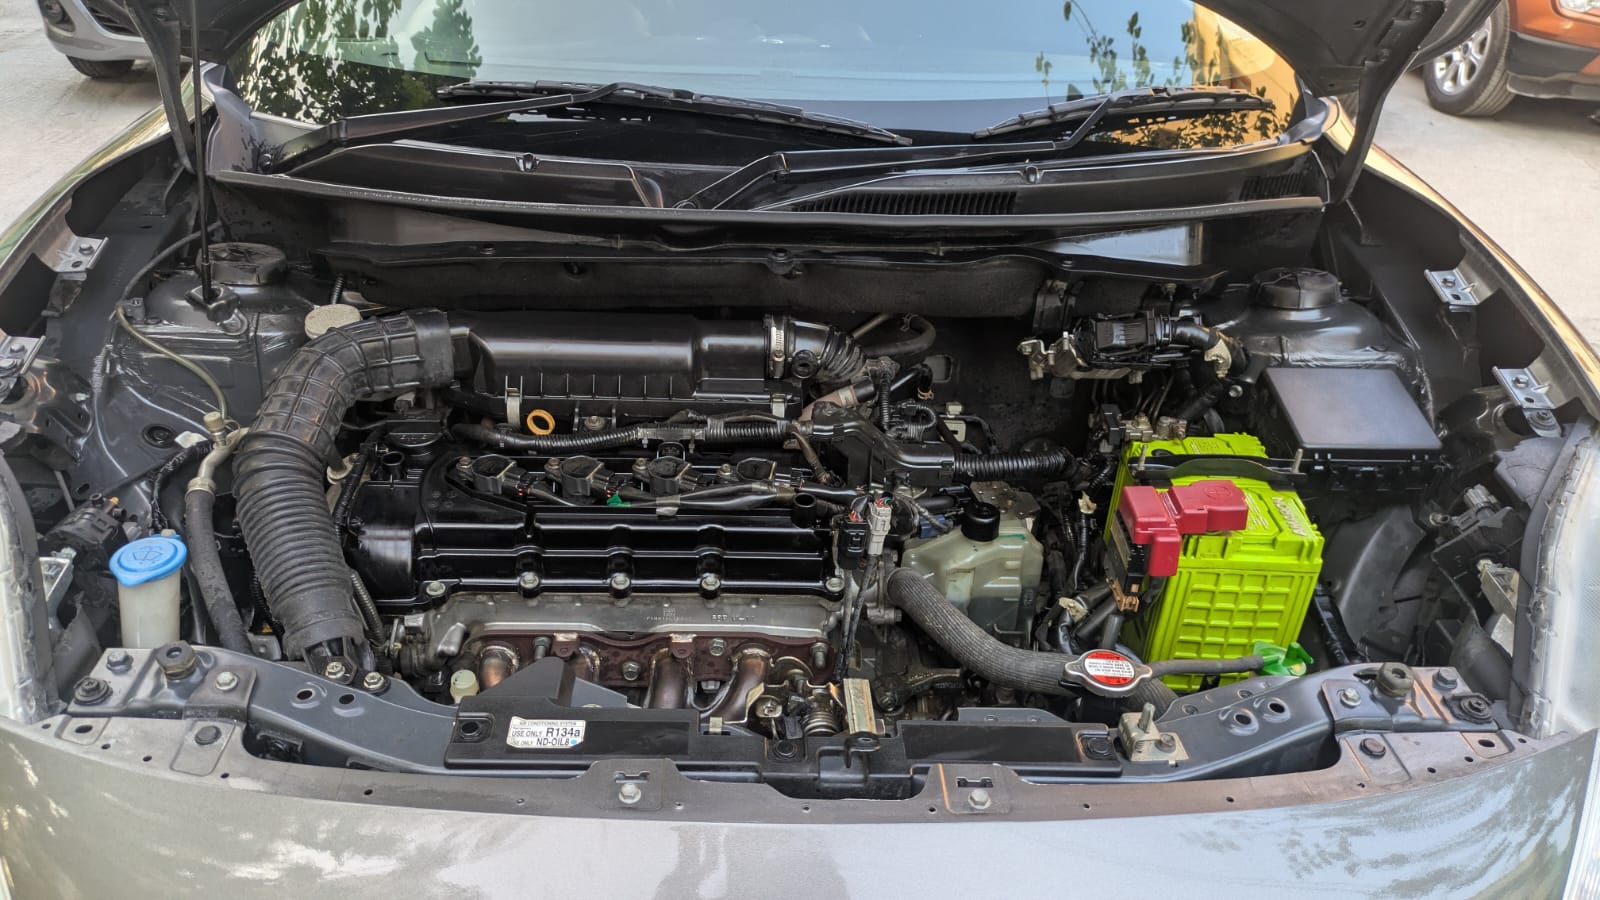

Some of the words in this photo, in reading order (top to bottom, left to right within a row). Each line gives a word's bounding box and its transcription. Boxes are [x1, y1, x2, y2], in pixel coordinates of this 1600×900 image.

[526, 730, 543, 738] ONLY
[546, 727, 581, 737] R134a
[537, 737, 570, 746] ND-OIL8
